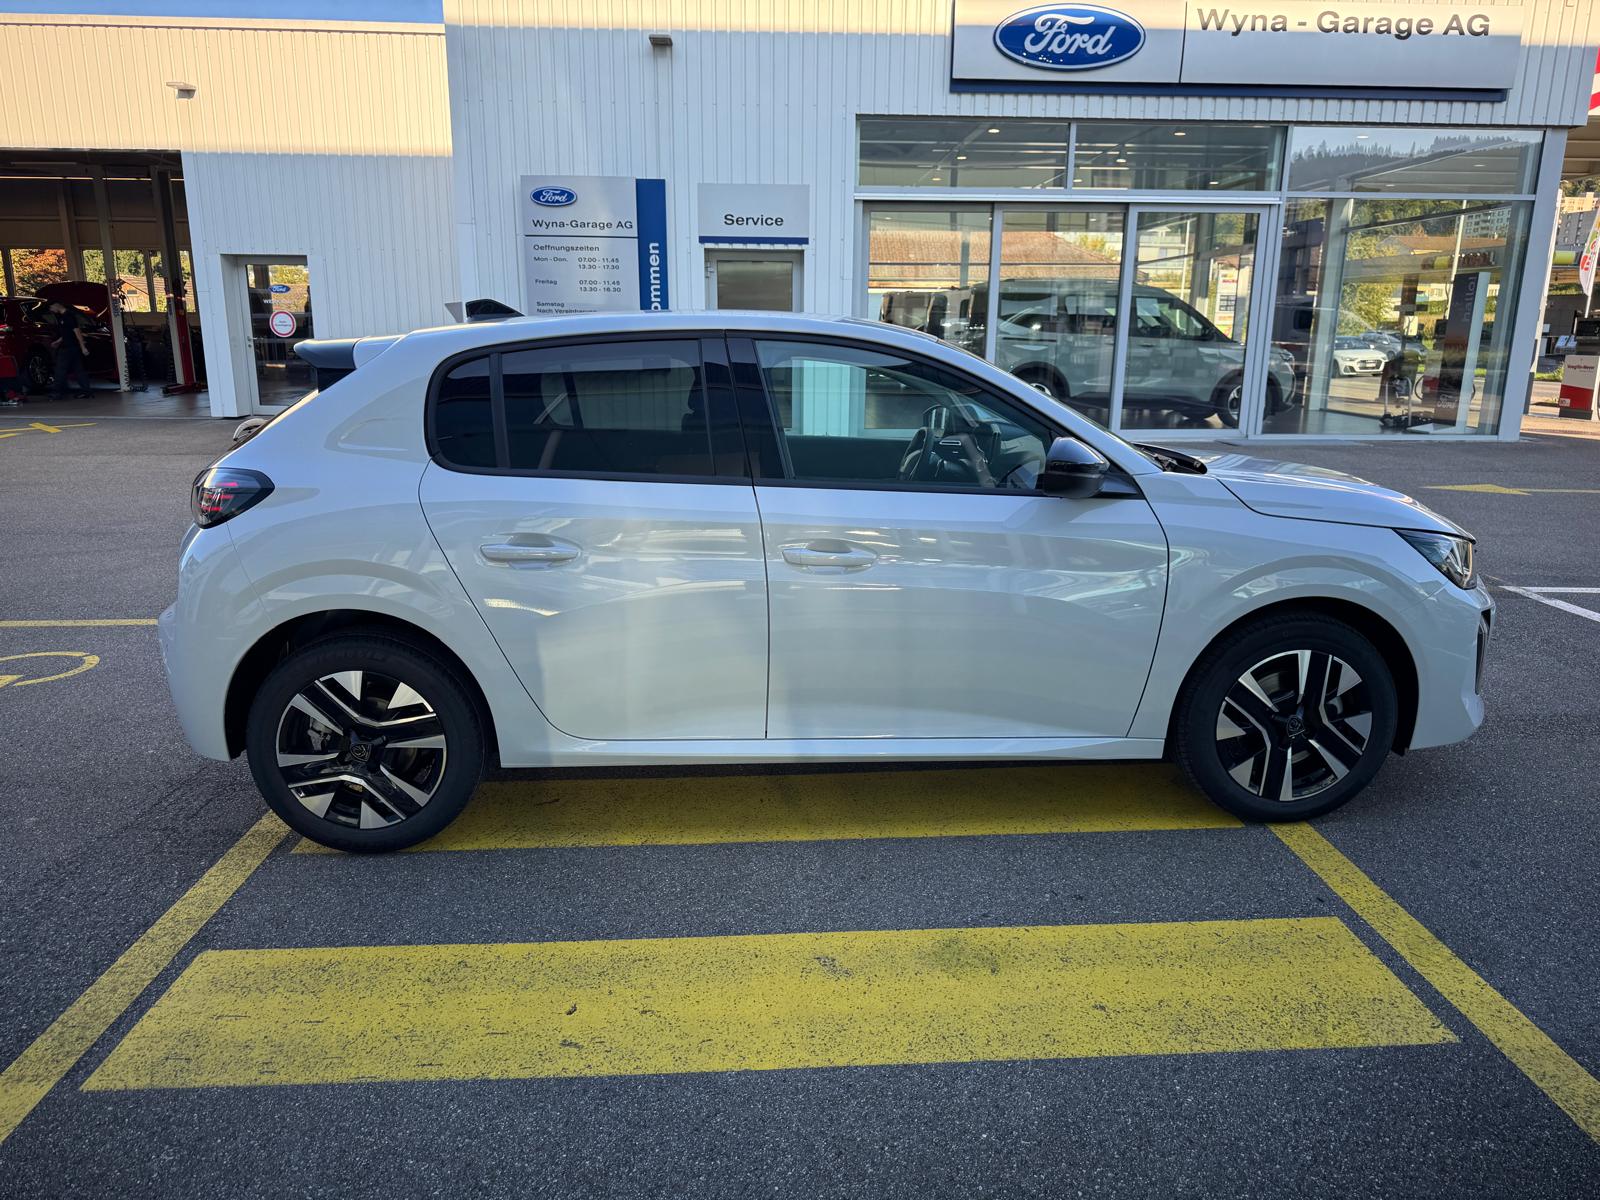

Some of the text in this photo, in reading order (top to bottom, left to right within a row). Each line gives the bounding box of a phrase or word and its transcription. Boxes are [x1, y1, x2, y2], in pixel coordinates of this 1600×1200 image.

[1197, 8, 1288, 36] Wyna
[1316, 10, 1434, 40] Garage
[1442, 13, 1490, 36] AG
[1024, 13, 1116, 55] Ford
[539, 189, 568, 203] Ford
[532, 219, 633, 230] Wyna-Garage AG
[723, 213, 784, 227] Service
[533, 243, 600, 252] Oeffnungszeiten
